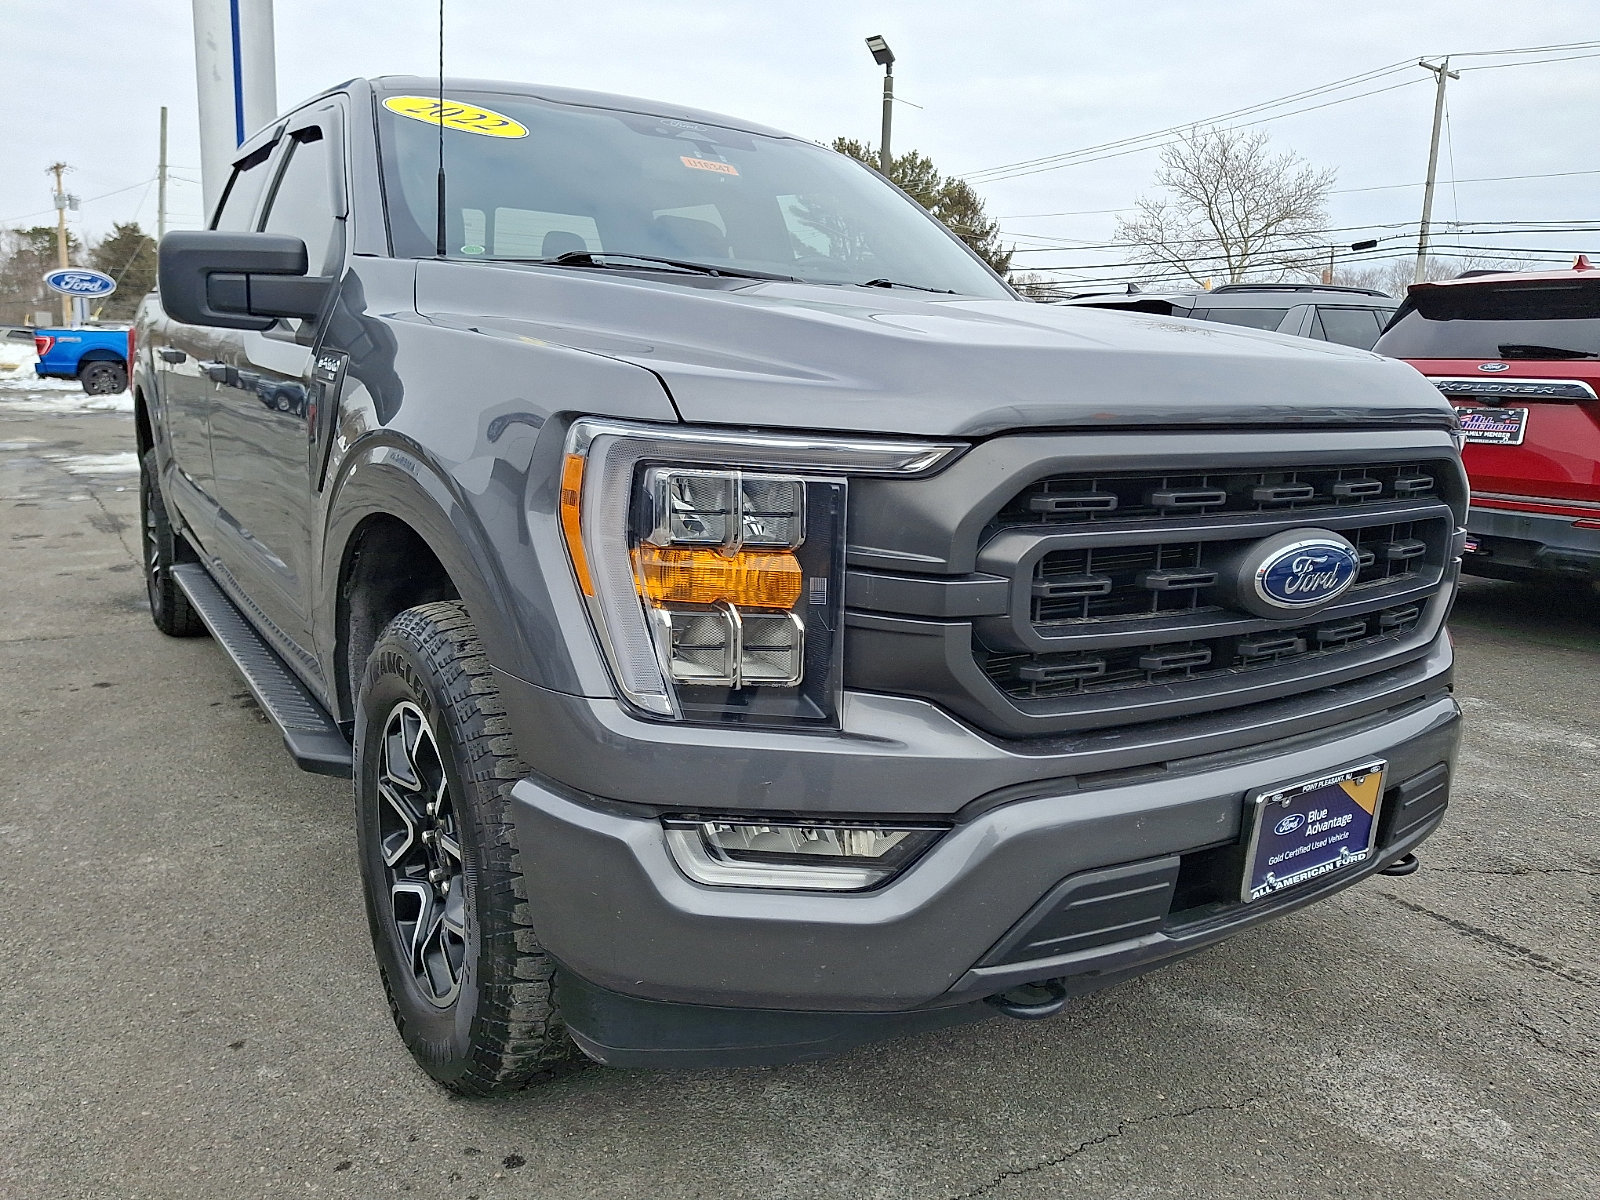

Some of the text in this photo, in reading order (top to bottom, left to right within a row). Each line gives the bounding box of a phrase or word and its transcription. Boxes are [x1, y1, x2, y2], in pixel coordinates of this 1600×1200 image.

[405, 102, 510, 131] 2022
[60, 274, 102, 293] Ford
[1284, 555, 1341, 595] Ford
[1302, 783, 1319, 793] POINT
[1279, 816, 1300, 833] Ford
[1304, 813, 1353, 837] Advantage
[1307, 808, 1328, 823] Blue
[1268, 830, 1350, 866] Gold Certified Used Vehicle
[1252, 853, 1367, 900] ALL AMERICAN FORD
